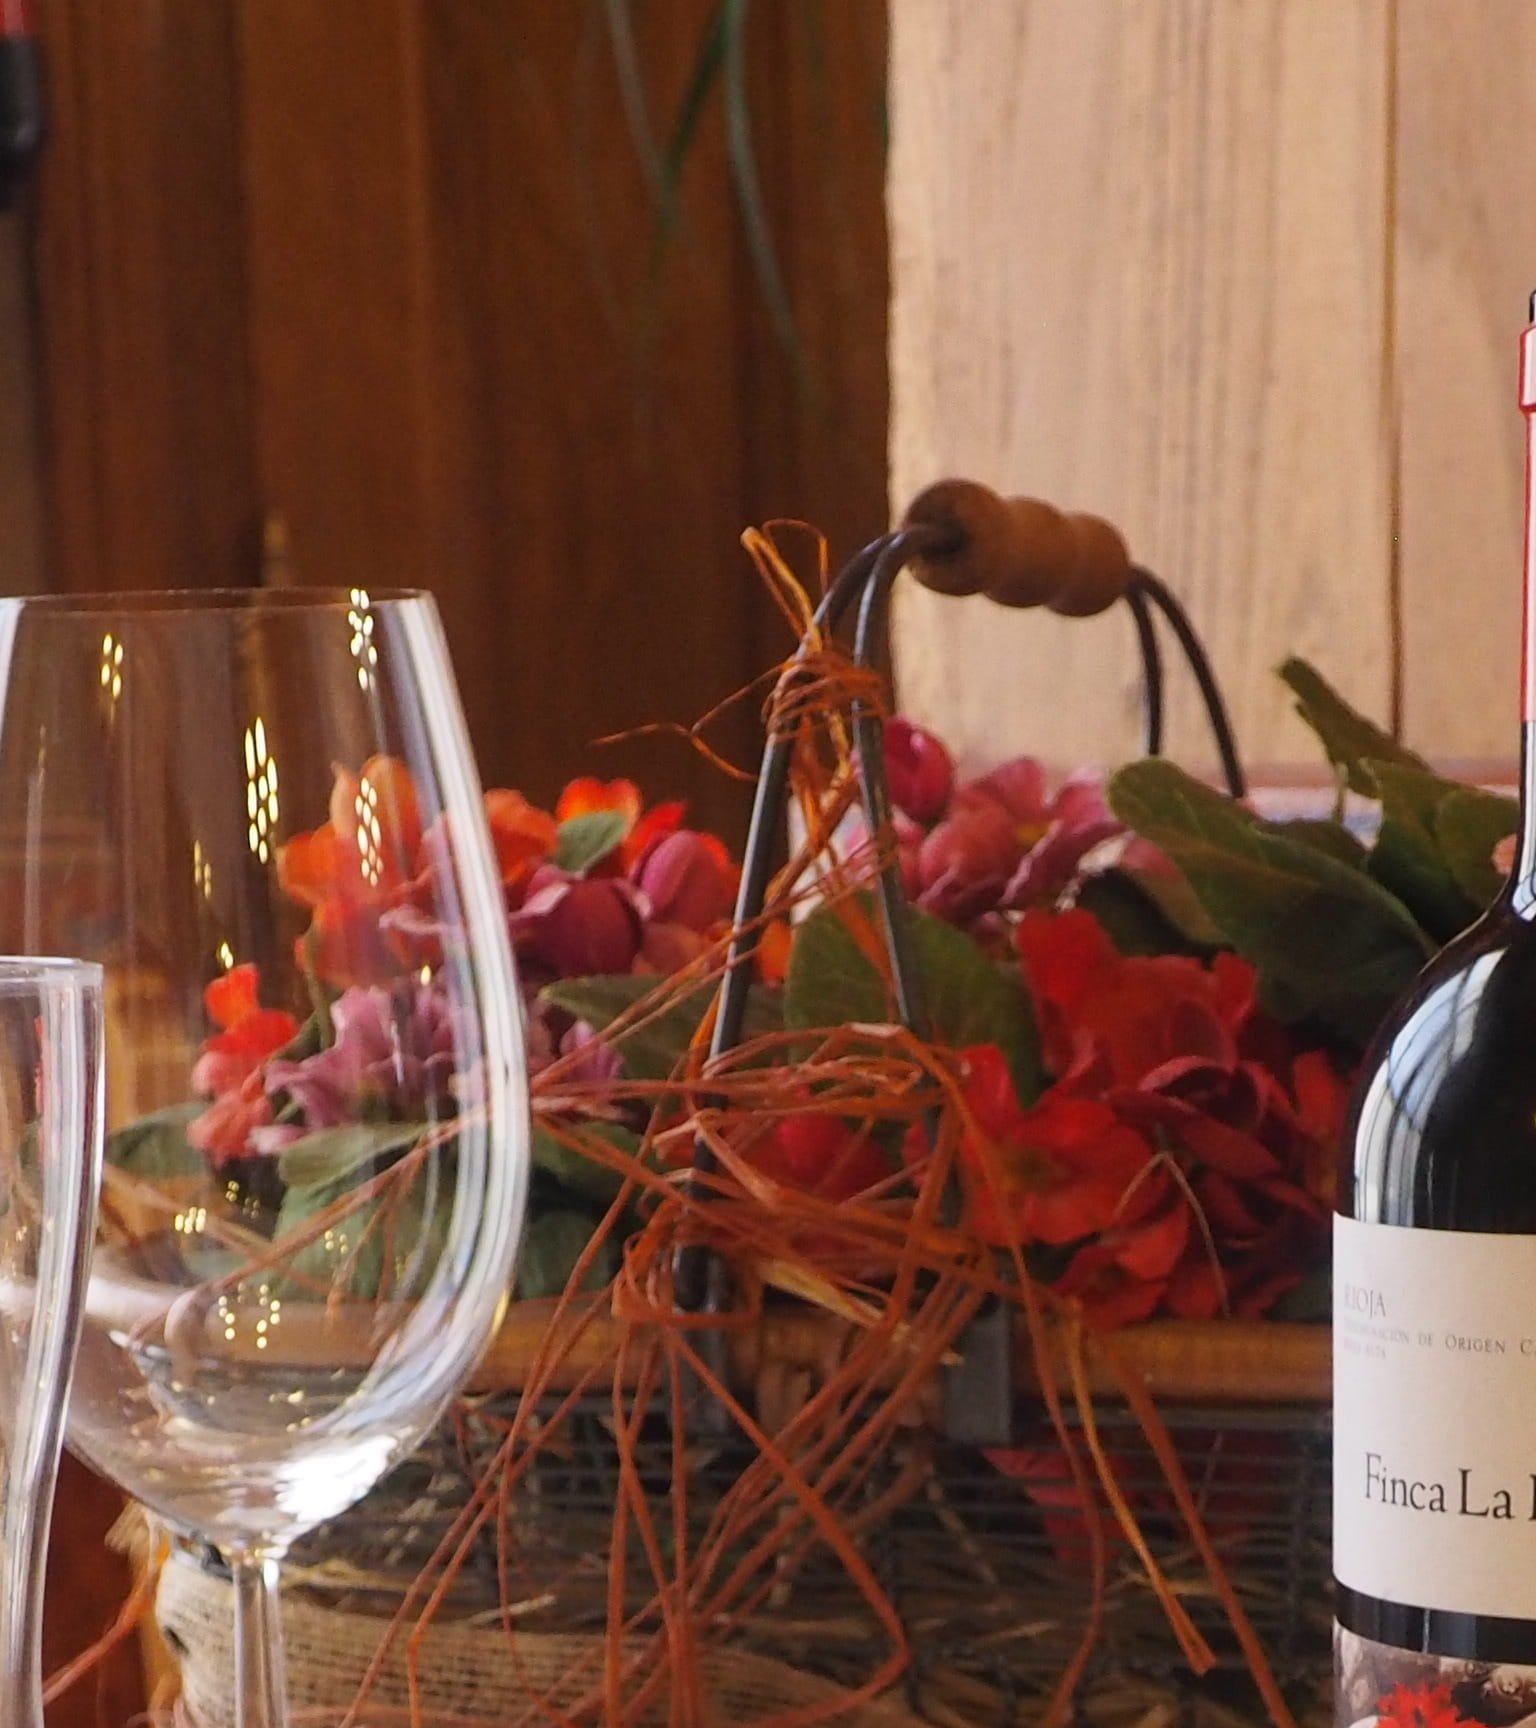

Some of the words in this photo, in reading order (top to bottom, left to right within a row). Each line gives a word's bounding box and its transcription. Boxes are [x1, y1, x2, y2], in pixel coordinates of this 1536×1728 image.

[1444, 1333, 1506, 1355] ORIGEN
[1364, 1452, 1448, 1514] Finca
[1458, 1467, 1514, 1521] La
